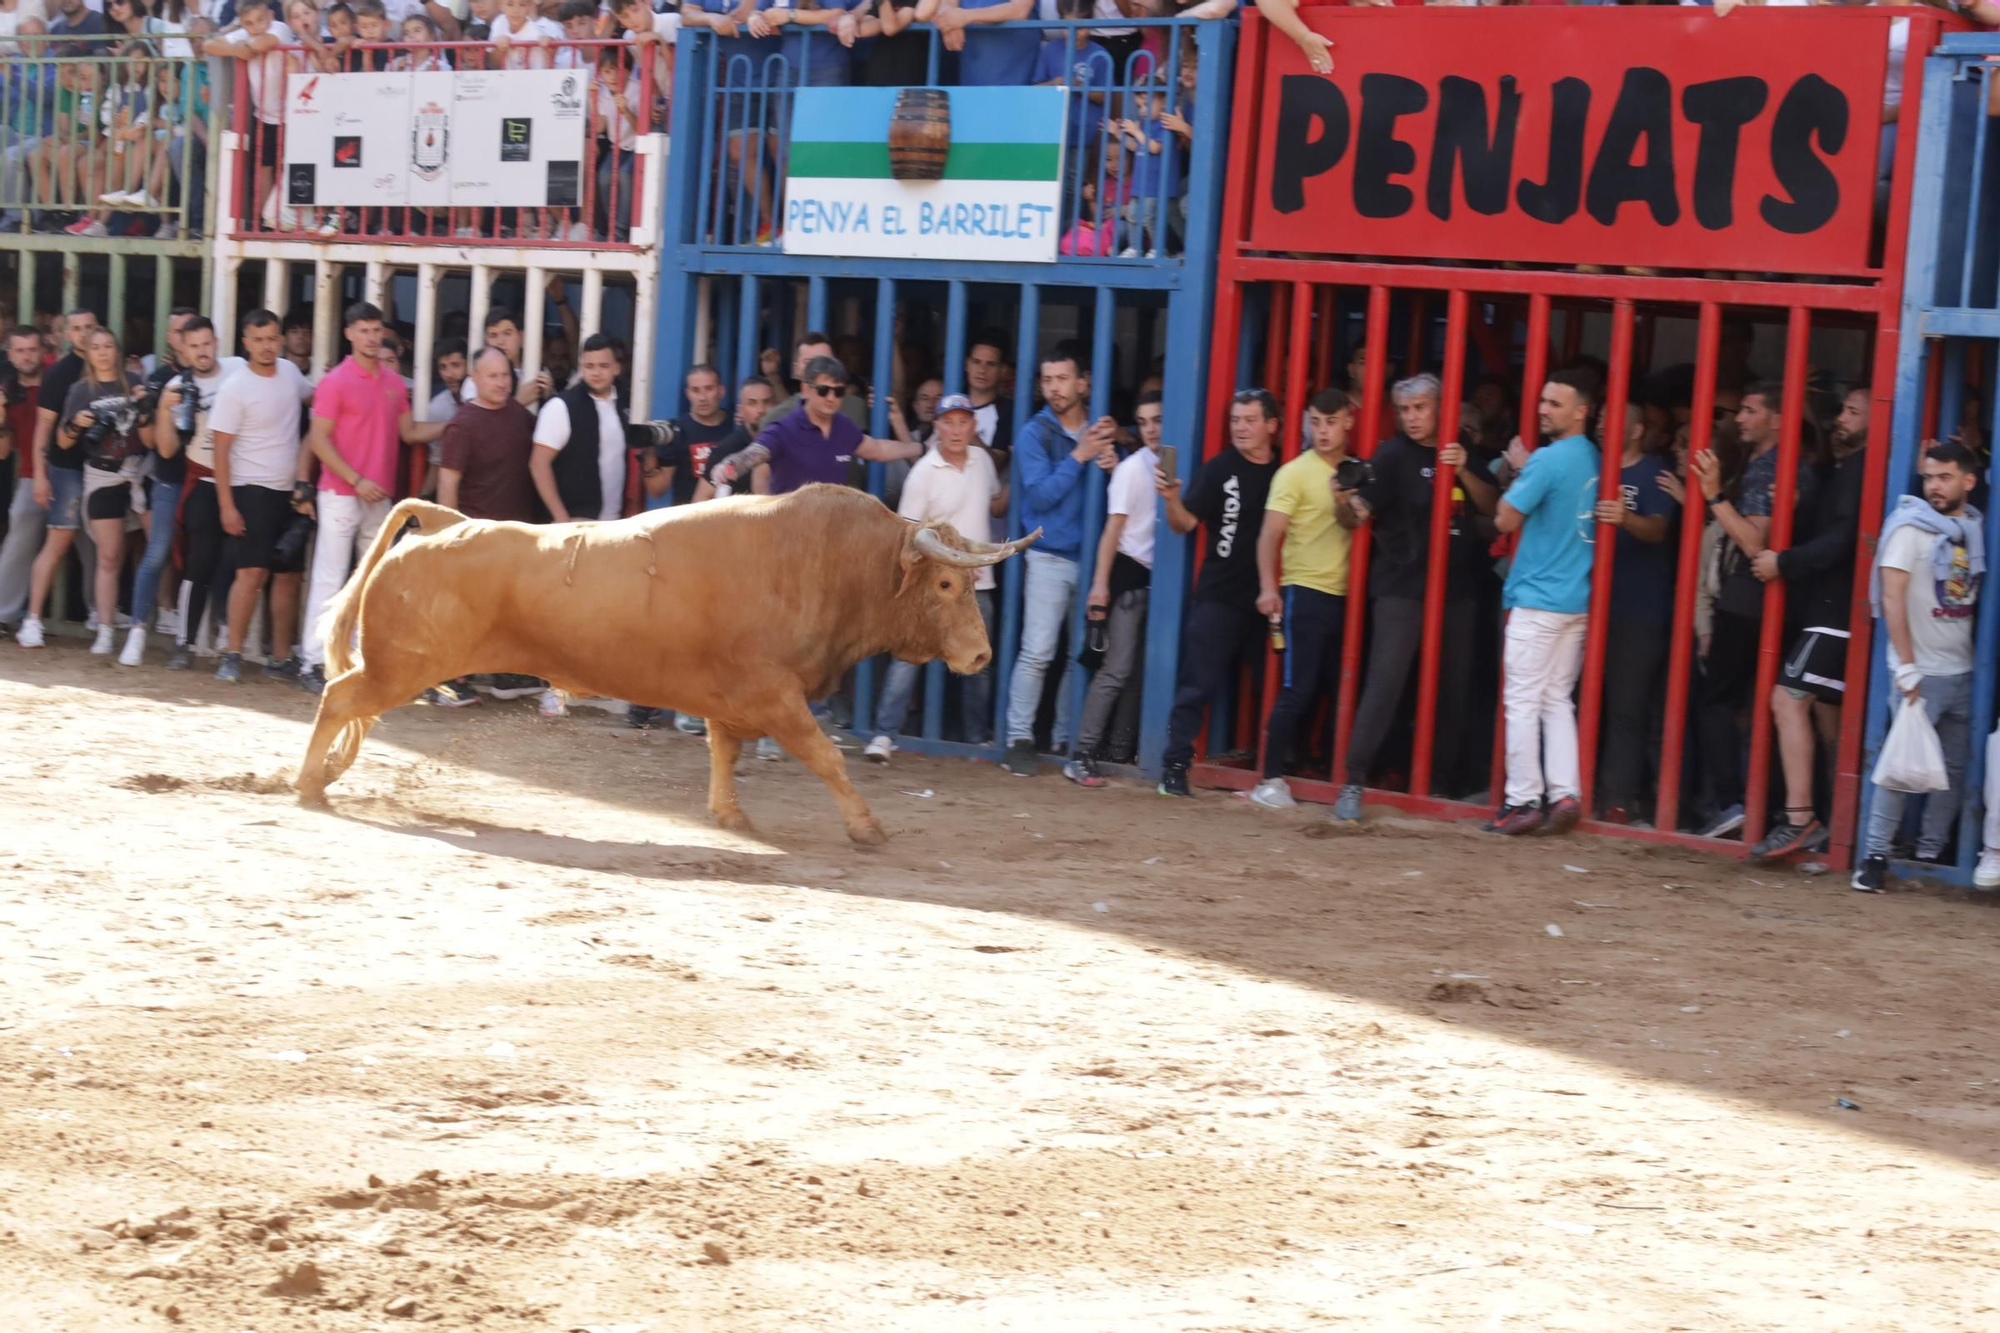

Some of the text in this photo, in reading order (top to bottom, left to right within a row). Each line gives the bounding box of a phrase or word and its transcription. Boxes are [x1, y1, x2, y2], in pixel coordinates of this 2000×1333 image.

[1271, 66, 1850, 235] PENJATS
[787, 199, 1053, 239] PENYA EL BARRILET
[1216, 474, 1241, 558] VOLVO
